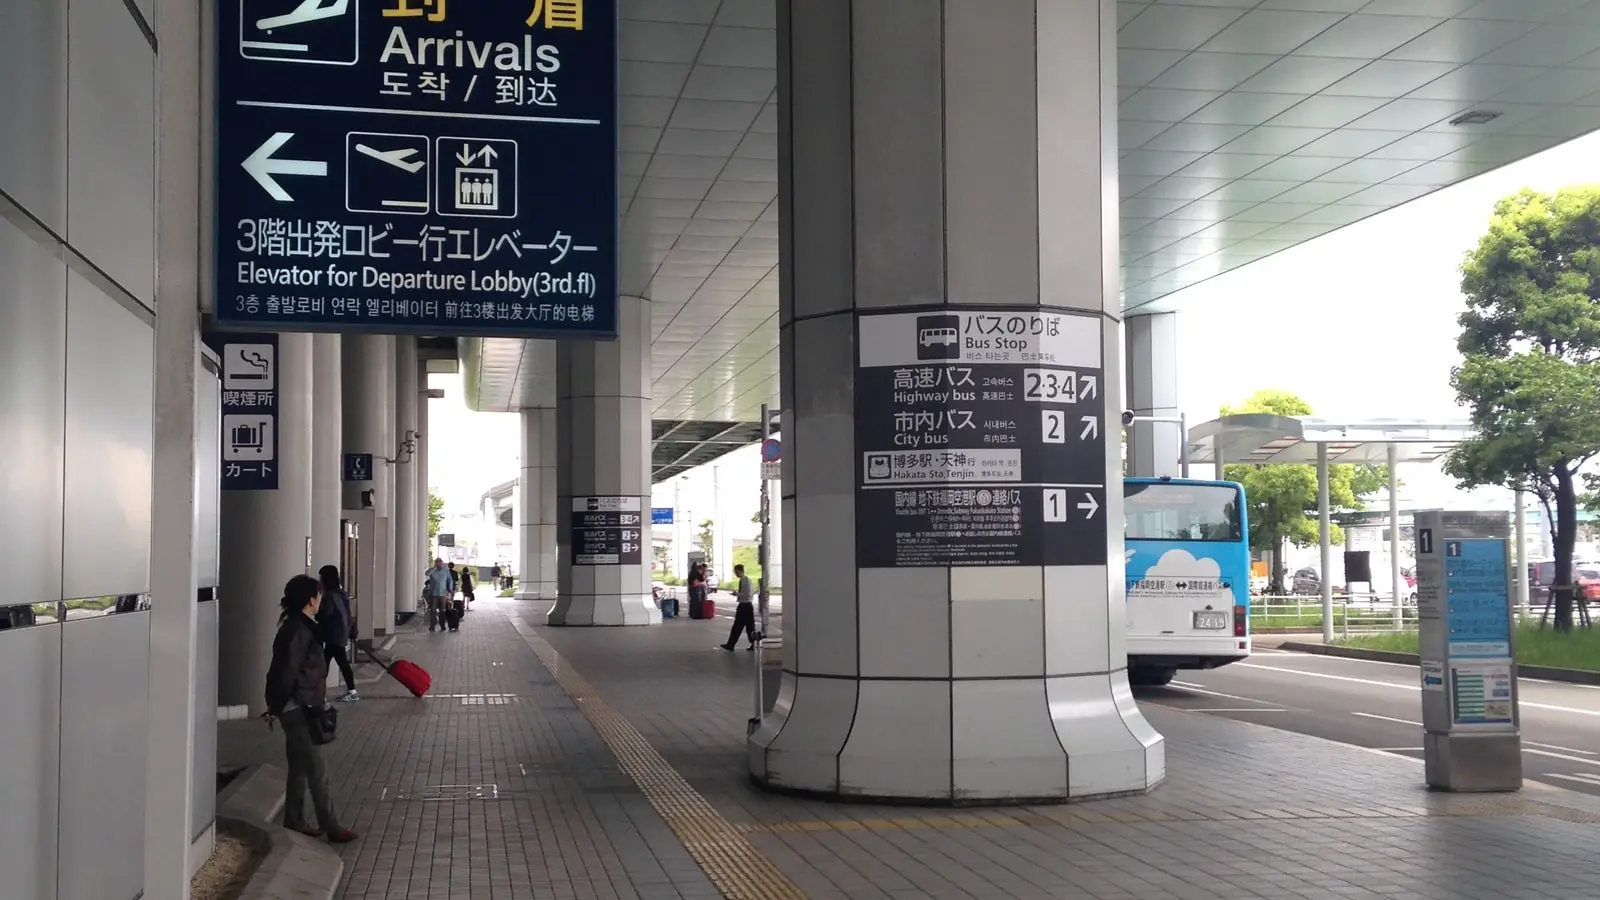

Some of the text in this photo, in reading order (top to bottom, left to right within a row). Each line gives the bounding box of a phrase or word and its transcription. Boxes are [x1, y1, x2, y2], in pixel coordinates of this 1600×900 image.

[379, 26, 560, 73] Arrivals
[379, 71, 558, 106] 도착 / 到达
[237, 218, 597, 265] 3階出発ロビー行エレベーター
[238, 261, 596, 299] Elevator for Departure Lobby(3rd.fl)
[236, 294, 595, 322] 3층 출발로비 연락 엘리베이터 前往3楼出发大厅的电梯
[964, 314, 1061, 337] バスのりば
[965, 337, 1027, 352] Bus Stop
[893, 366, 975, 389] 高速バス
[982, 377, 1014, 387] 고속버스
[223, 391, 274, 406] 喫煙所
[894, 389, 976, 405] Highway bus
[894, 408, 976, 432] 市内バス
[1048, 414, 1060, 440] 2
[894, 432, 949, 448] City bus
[226, 462, 272, 478] カート
[894, 470, 926, 479] Hakata
[1049, 492, 1058, 518] 1
[1421, 531, 1430, 552] 1
[1449, 543, 1457, 555] 1
